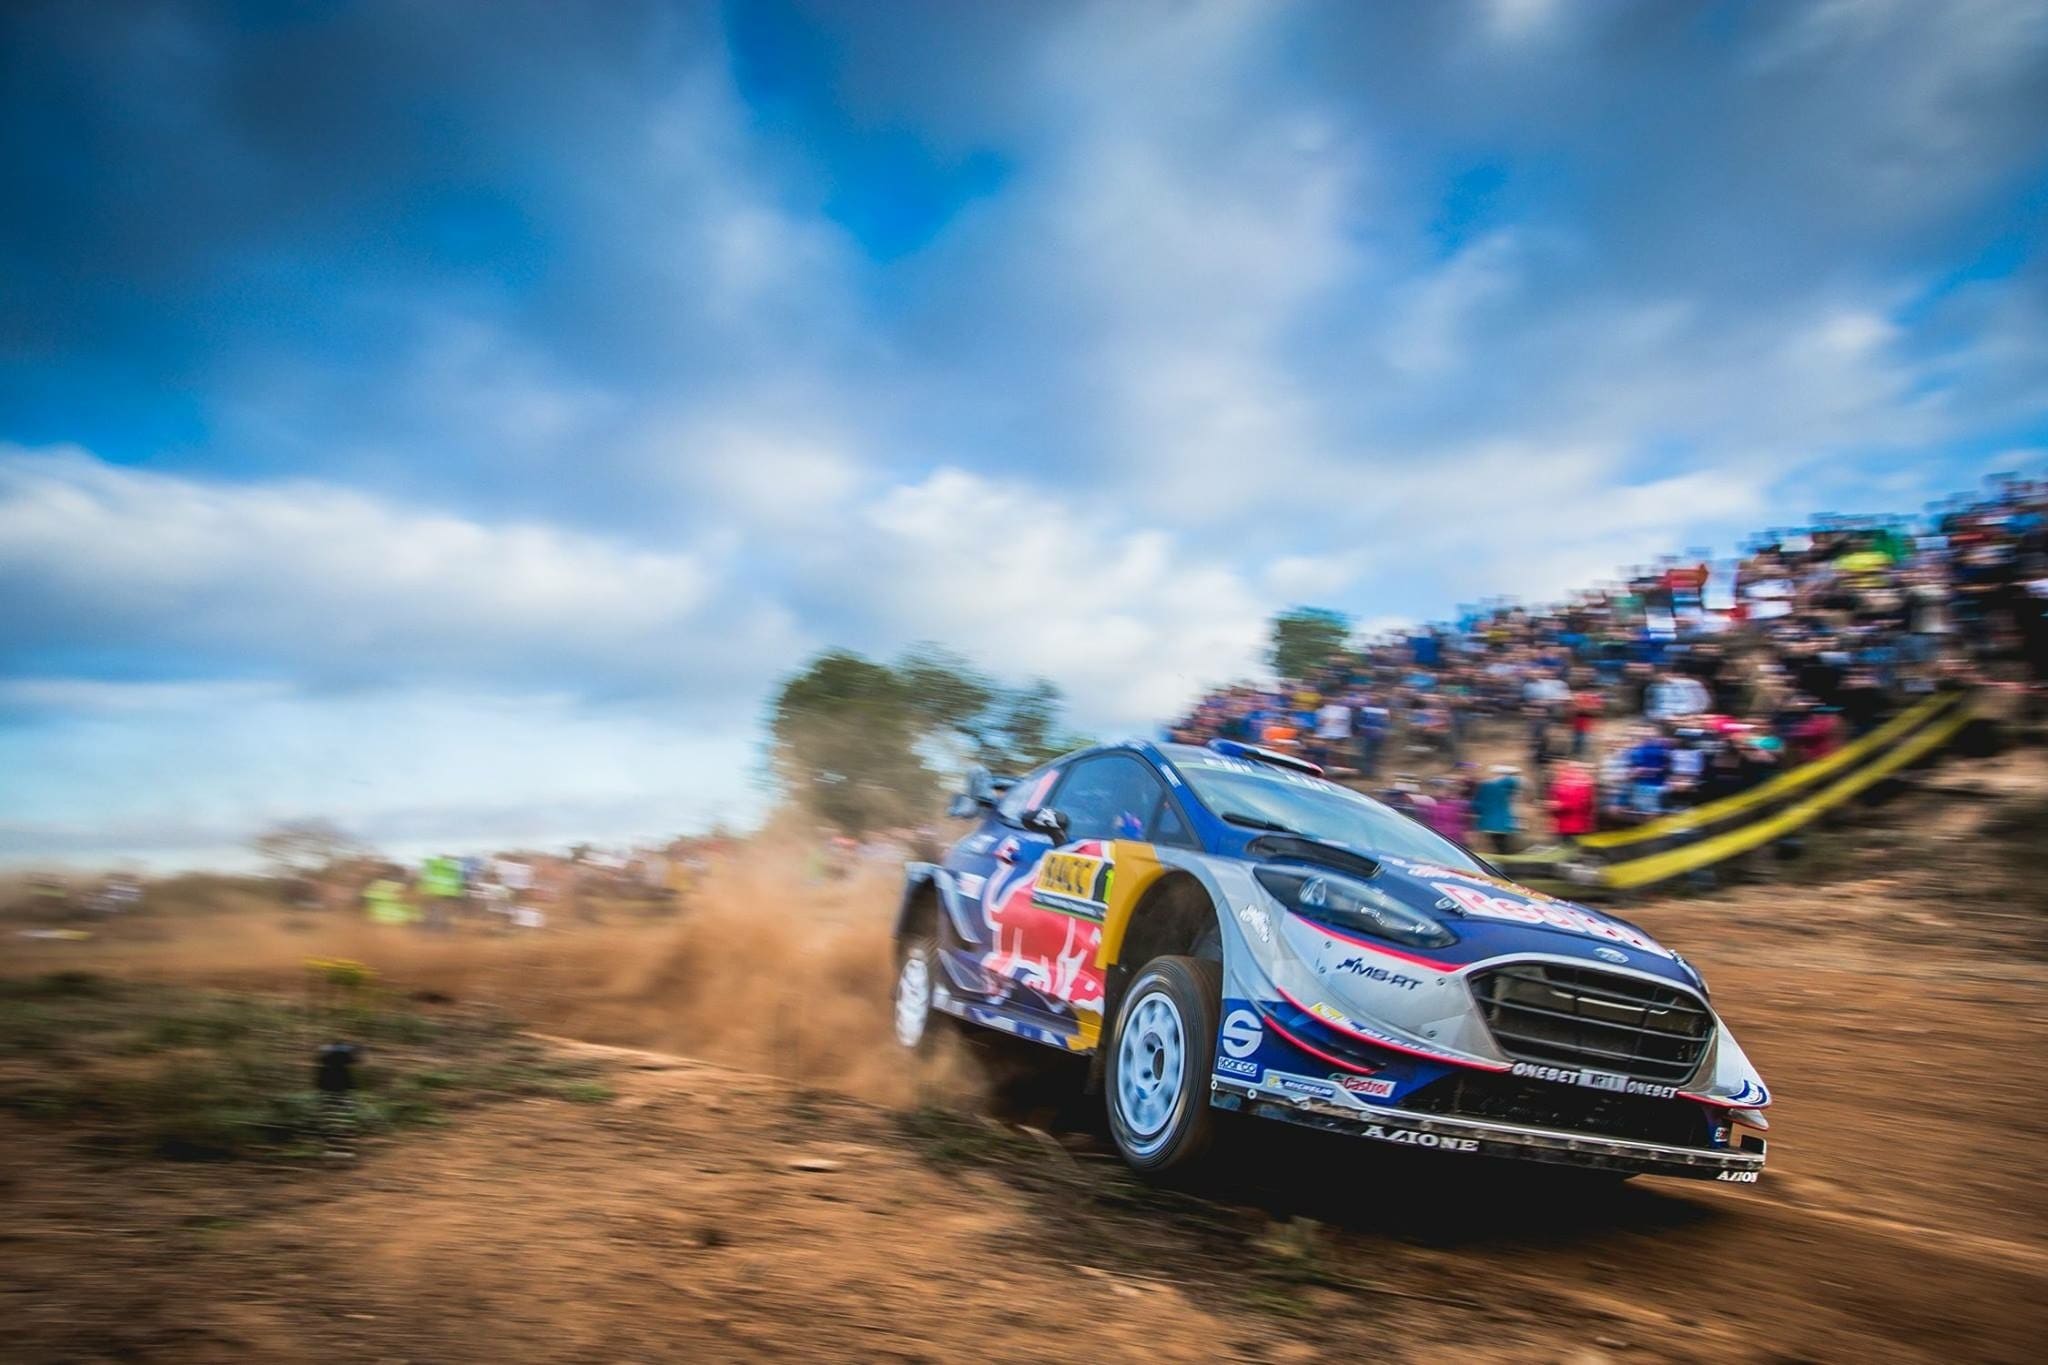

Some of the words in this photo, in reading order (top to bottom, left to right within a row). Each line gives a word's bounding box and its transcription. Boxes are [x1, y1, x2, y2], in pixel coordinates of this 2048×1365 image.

[1351, 963, 1423, 990] MS-RT
[1512, 1063, 1579, 1084] ONEBET
[1344, 1077, 1388, 1095] Castrol
[1626, 1081, 1679, 1099] ONEBET
